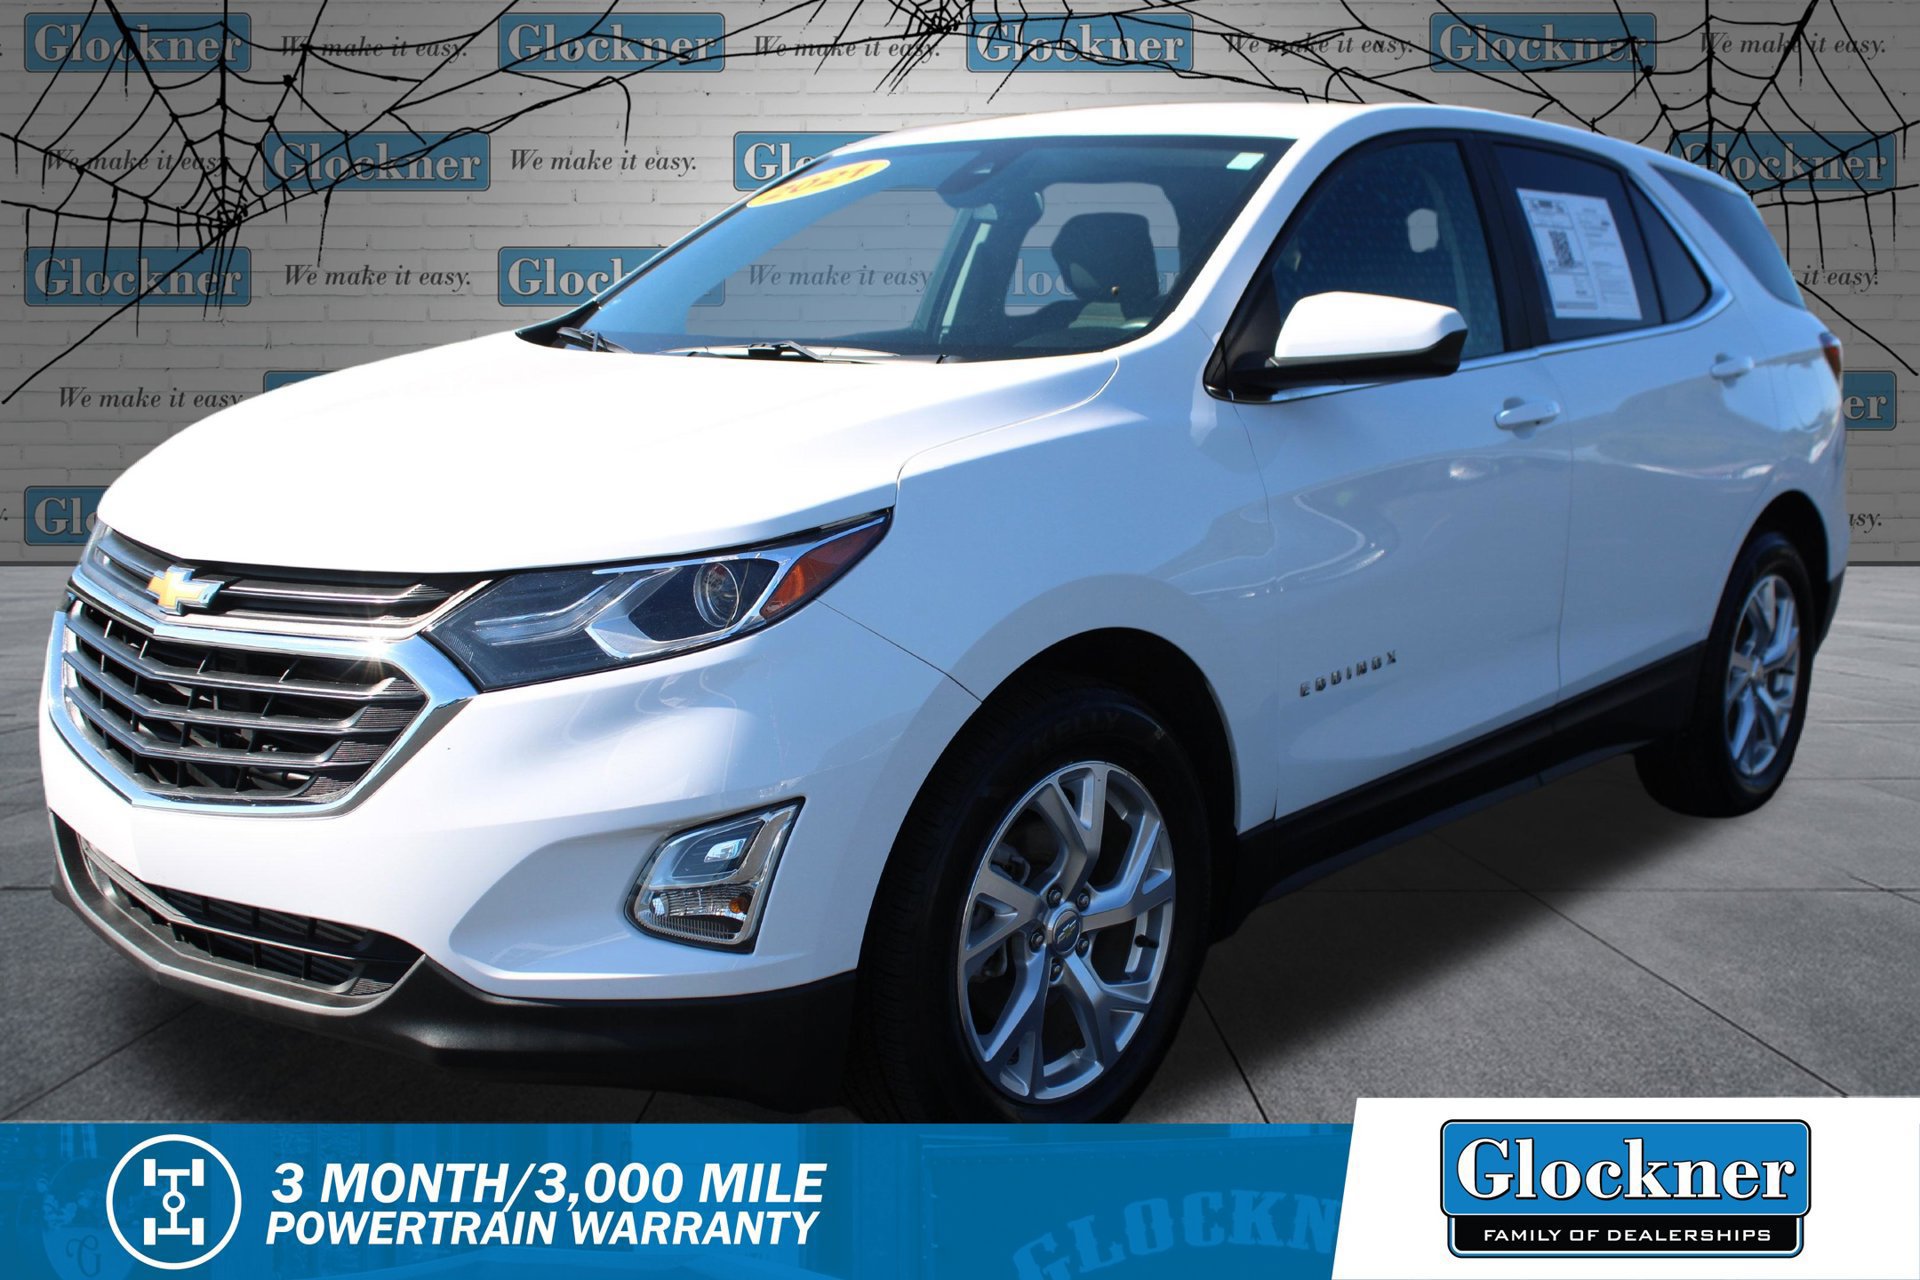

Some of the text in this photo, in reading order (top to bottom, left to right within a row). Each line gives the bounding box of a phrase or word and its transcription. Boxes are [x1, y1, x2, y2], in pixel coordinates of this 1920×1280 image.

[34, 23, 242, 63] Glockner
[281, 35, 468, 64] W make it easy.
[508, 23, 716, 63] Glockner
[754, 35, 787, 57] We
[865, 35, 882, 57] it
[888, 42, 941, 64] easy.
[976, 23, 1184, 63] Glockner
[1227, 32, 1414, 61] We ke it easy.
[1439, 23, 1647, 63] Glockner
[1700, 32, 1733, 54] We
[1811, 32, 1828, 54] it
[1834, 39, 1887, 61] easy.
[47, 149, 80, 170] We
[86, 149, 149, 170] make
[157, 149, 174, 170] it
[273, 142, 481, 182] Glockner
[510, 149, 697, 178] We make it easy.
[34, 257, 242, 297] Glockner
[284, 264, 471, 293] We make it easy.
[507, 257, 632, 297] Gloc
[749, 264, 782, 286] We
[788, 264, 851, 286] make
[858, 264, 875, 286] it
[1803, 264, 1878, 292] it easy.
[58, 386, 92, 408] We
[99, 386, 161, 408] make
[169, 386, 185, 408] it
[1299, 649, 1397, 697] EQUINOX
